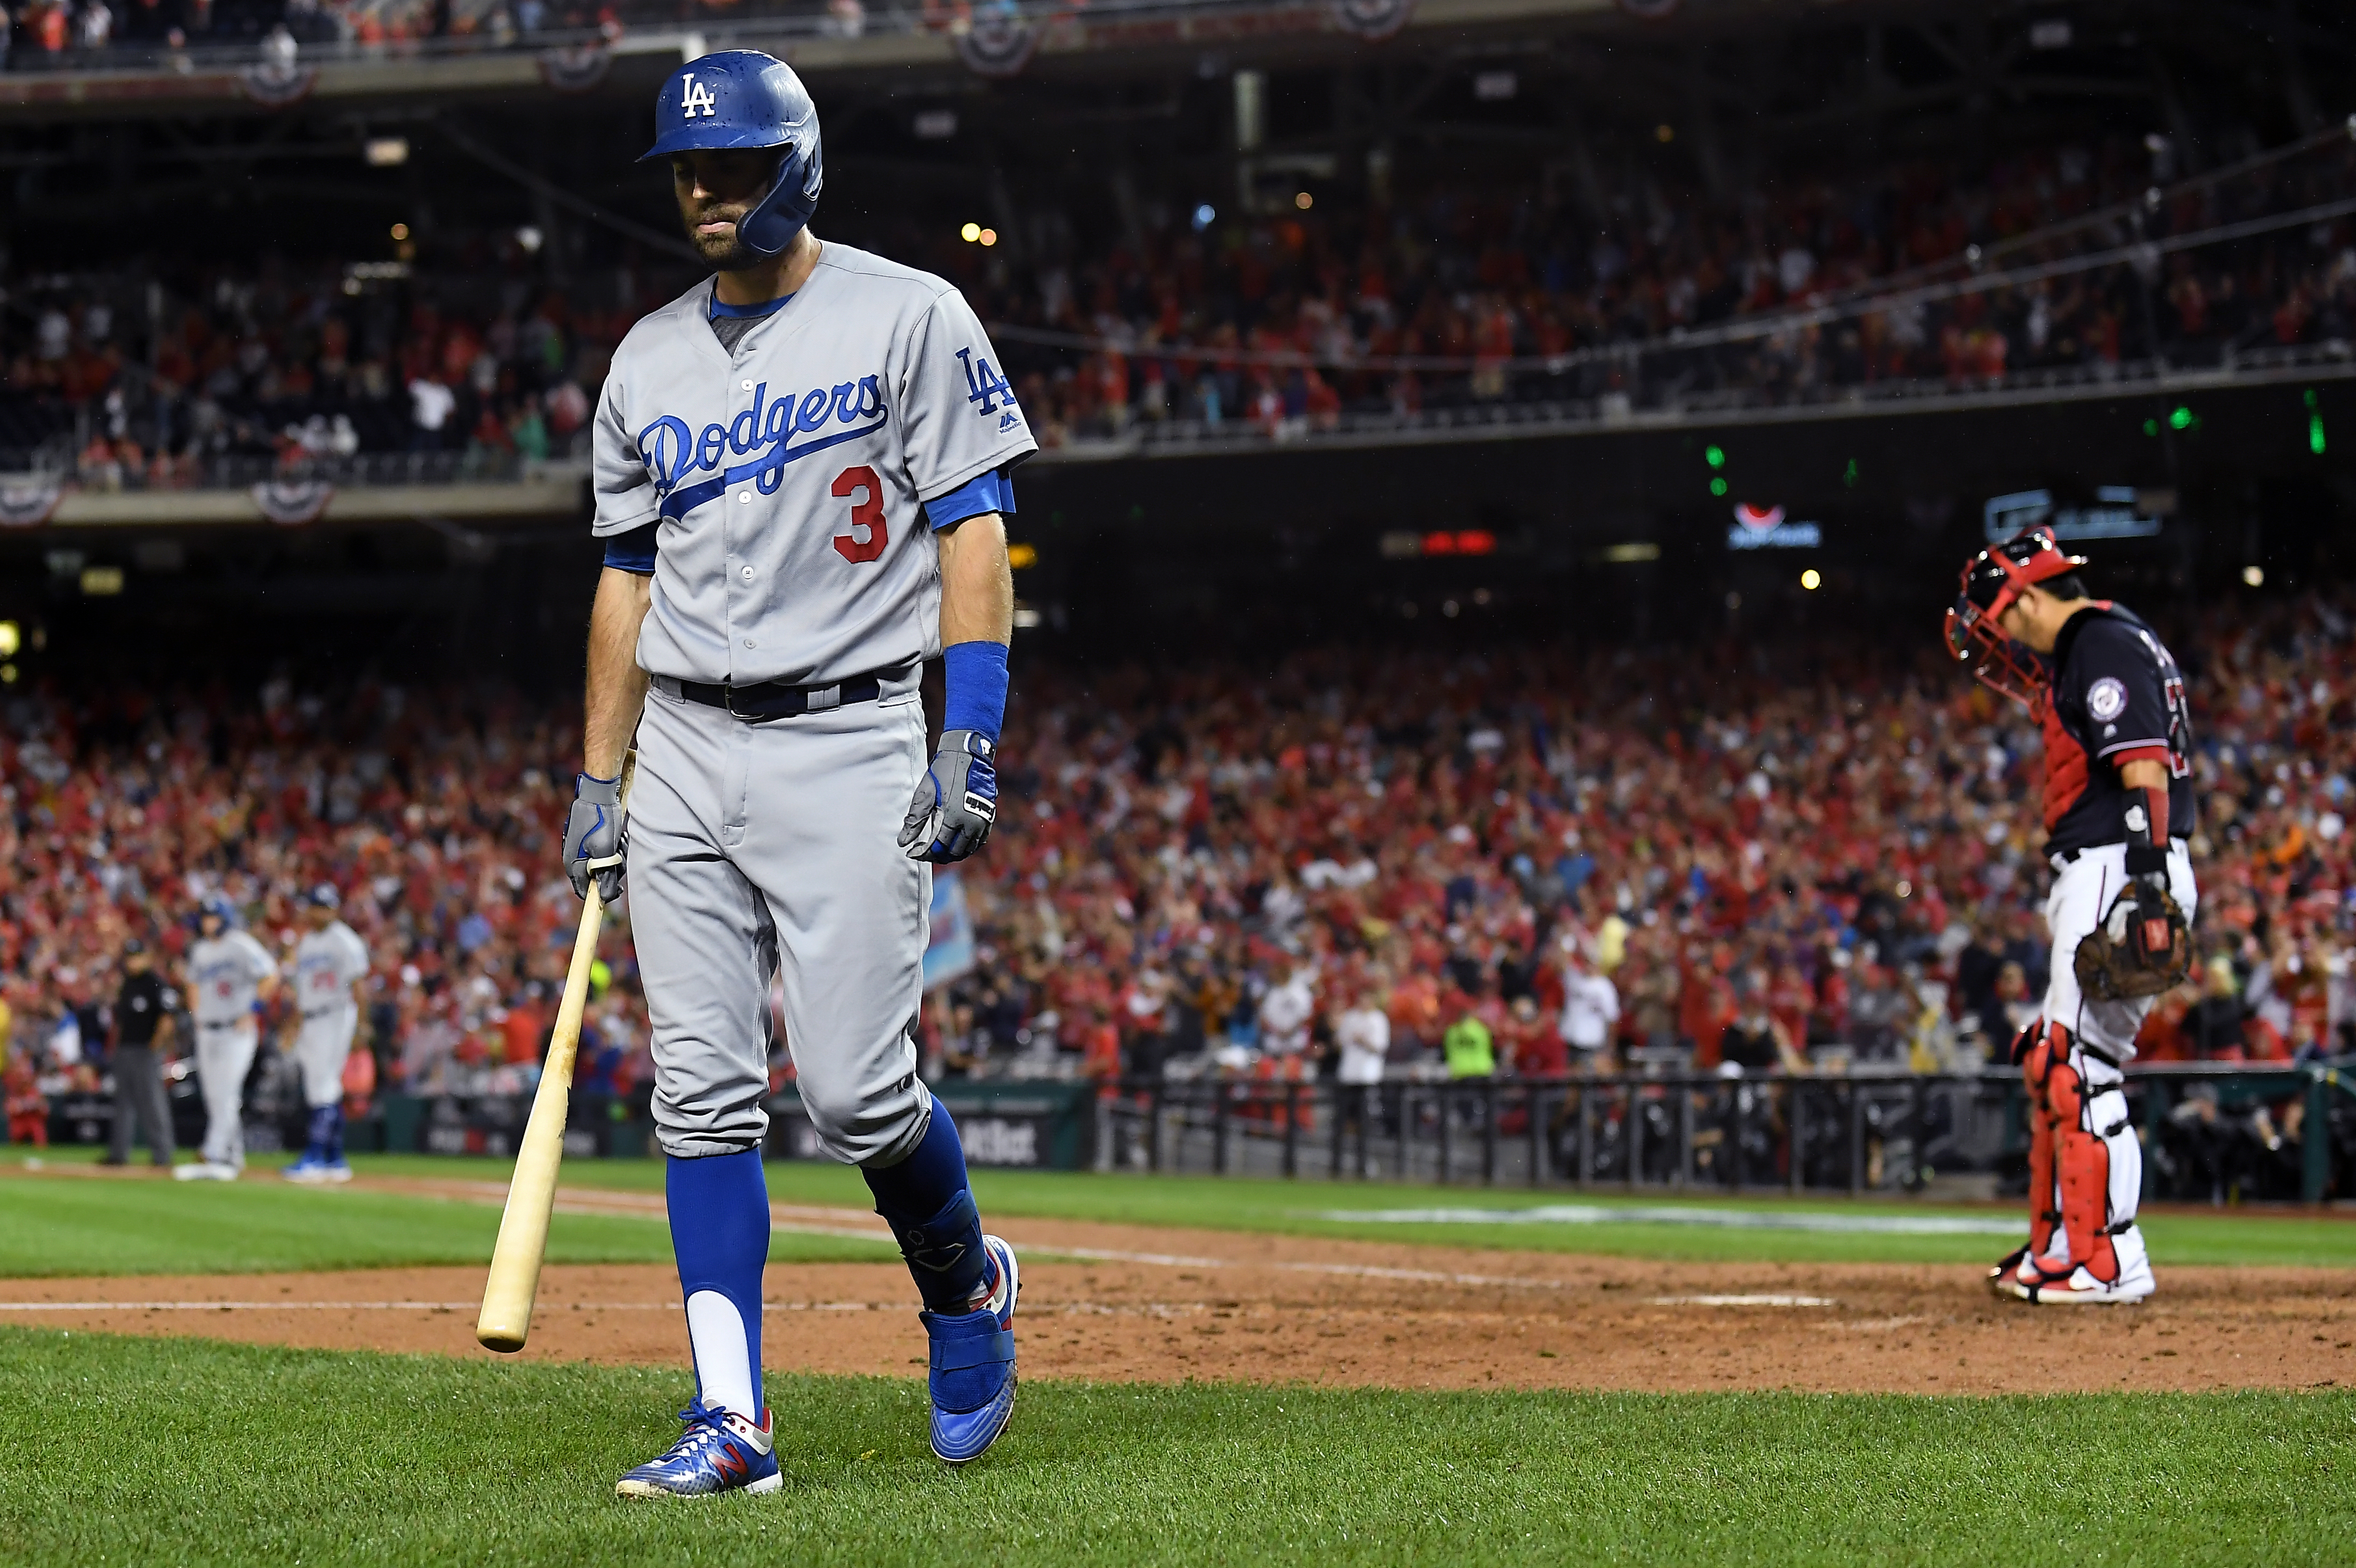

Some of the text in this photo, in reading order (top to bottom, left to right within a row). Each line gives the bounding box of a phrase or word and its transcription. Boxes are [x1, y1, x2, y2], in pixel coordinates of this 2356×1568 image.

[681, 73, 715, 118] LA
[955, 346, 1016, 416] LA
[637, 374, 888, 498] Dodgers
[831, 465, 889, 564] 3
